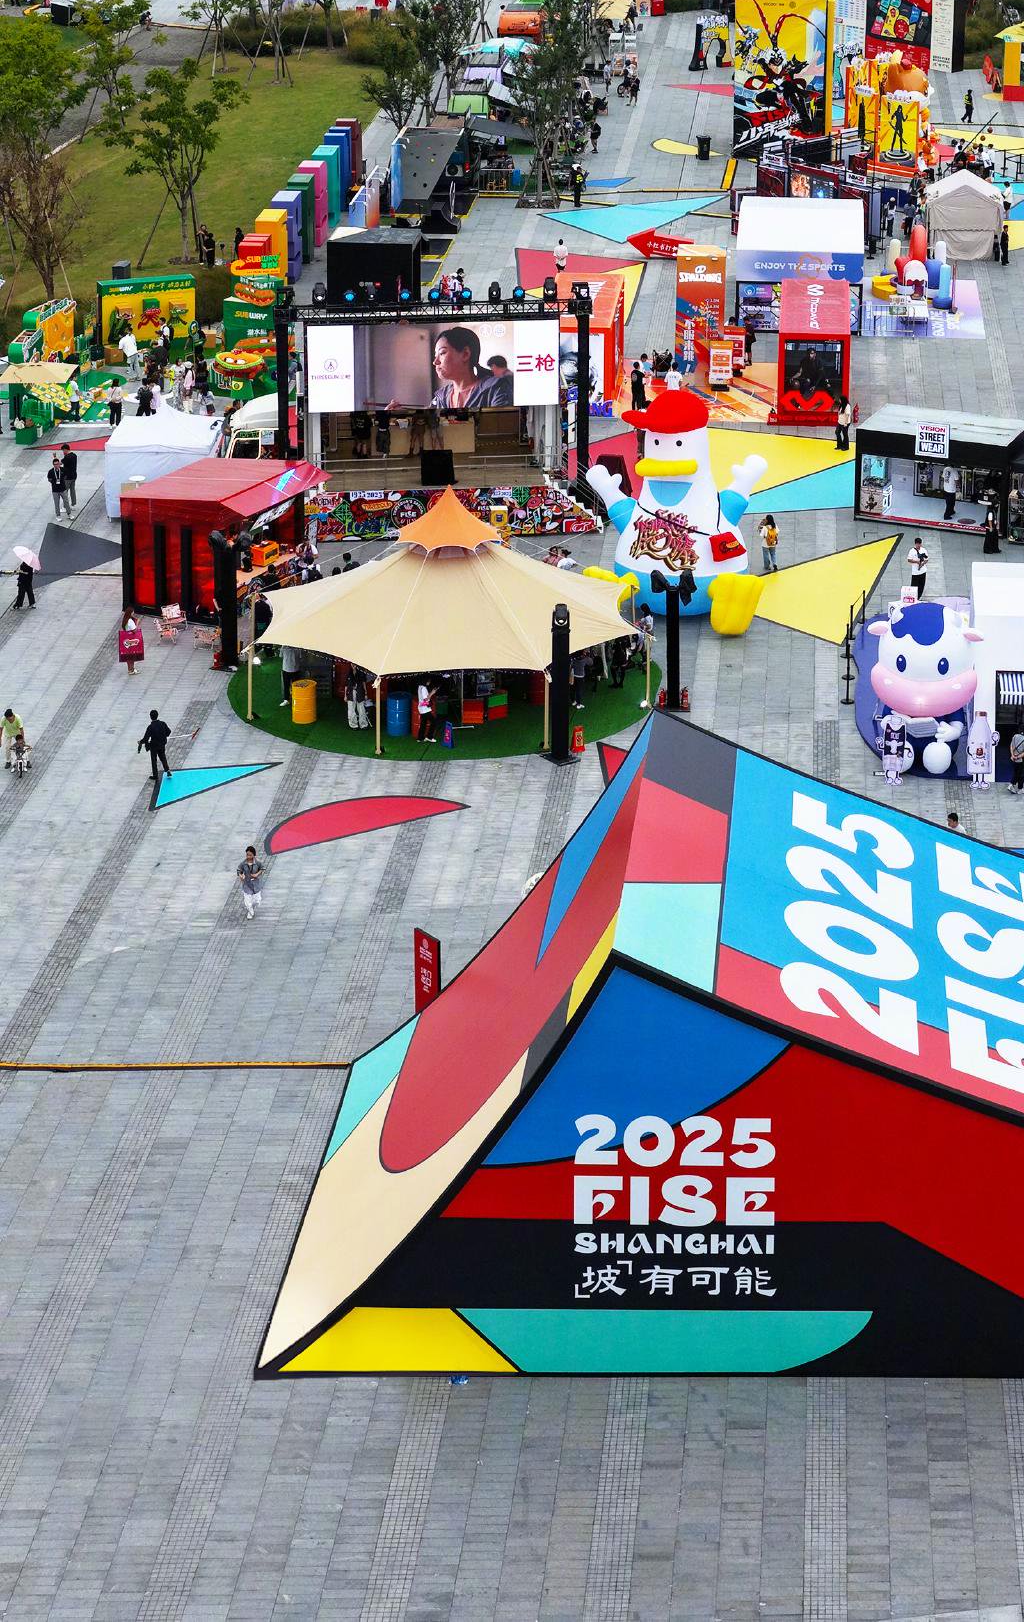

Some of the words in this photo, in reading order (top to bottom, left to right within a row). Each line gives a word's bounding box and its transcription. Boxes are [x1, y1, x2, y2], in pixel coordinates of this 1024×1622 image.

[245, 255, 280, 264] SUBWAY
[754, 261, 786, 270] ENJOY
[787, 262, 808, 271] THE
[807, 263, 846, 272] SPORTS
[678, 271, 723, 284] SPALDING
[234, 310, 268, 320] SUBWAY
[516, 352, 556, 373] 三枪
[920, 425, 946, 433] VISION
[919, 431, 946, 443] STREET
[920, 442, 944, 454] WEAR
[779, 790, 920, 1056] 2025
[574, 1114, 776, 1169] 2025
[573, 1174, 776, 1227] FISE
[573, 1232, 775, 1255] SHANGHAI
